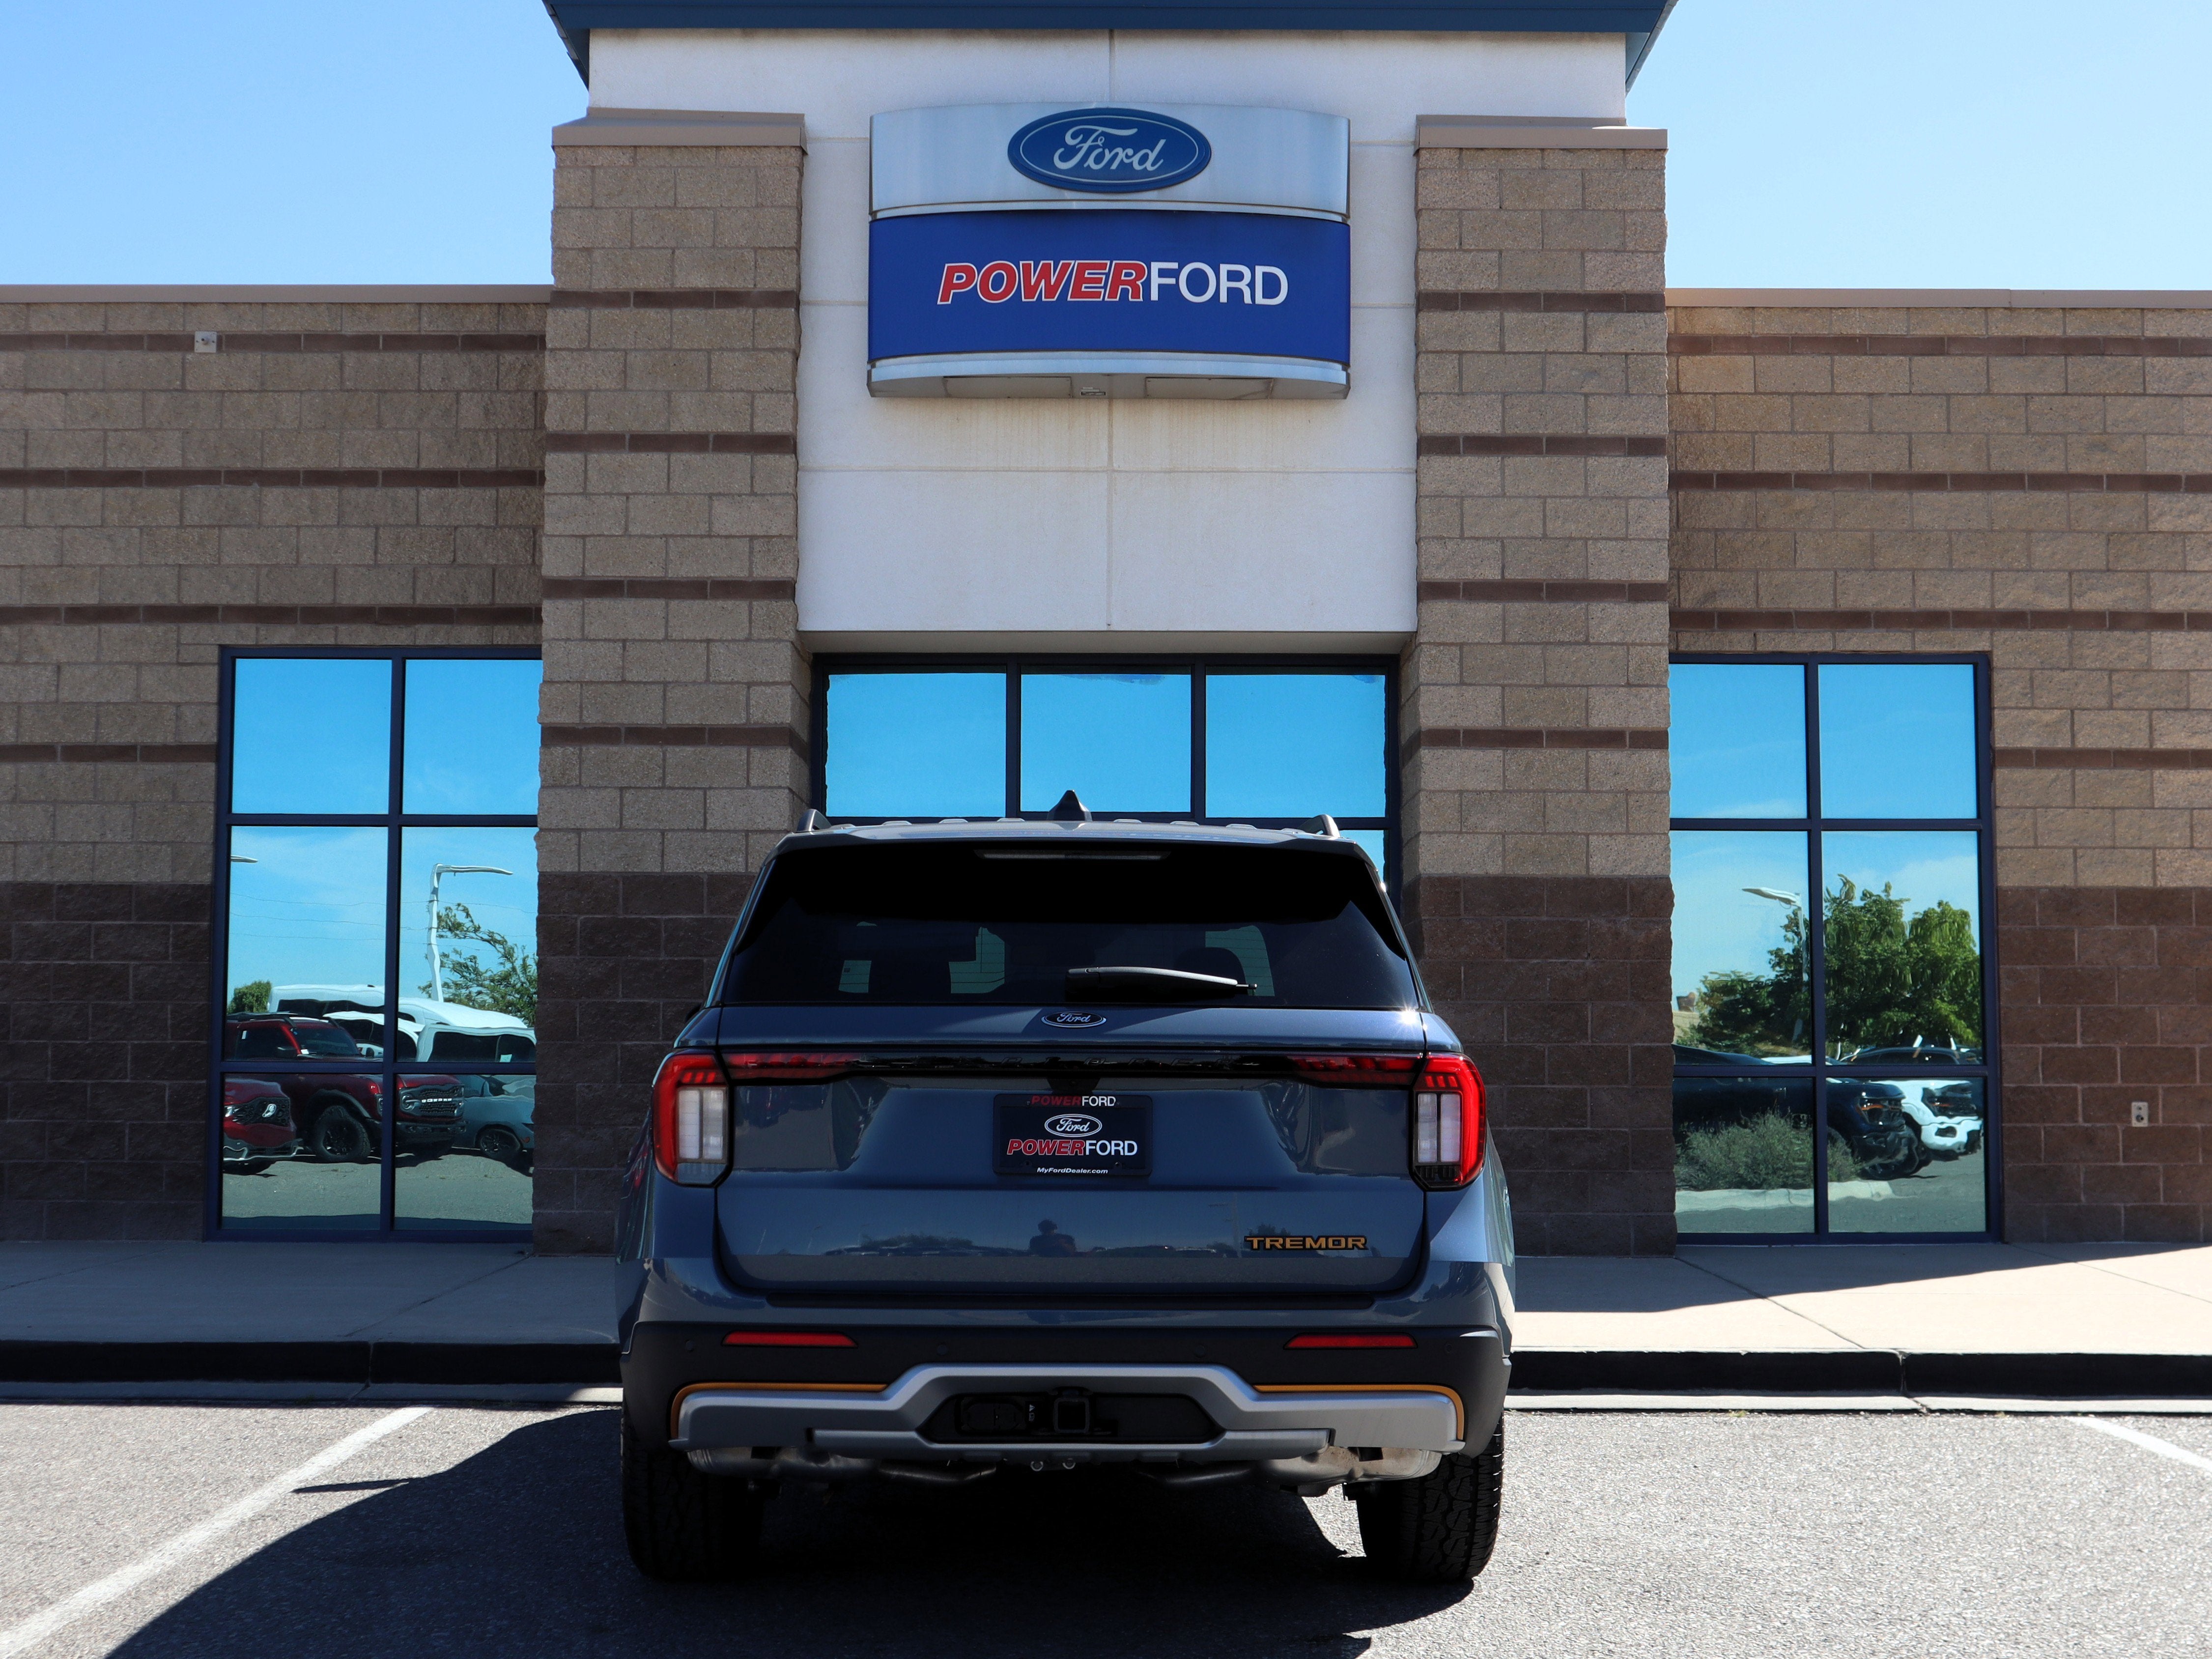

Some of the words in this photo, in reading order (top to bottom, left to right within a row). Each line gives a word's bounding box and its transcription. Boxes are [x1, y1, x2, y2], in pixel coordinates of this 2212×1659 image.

[1053, 124, 1166, 172] Ford
[936, 260, 1289, 306] POWERFORD
[1056, 1011, 1091, 1023] Ford
[1031, 1095, 1116, 1107] POWERFORD
[1056, 1117, 1091, 1132] Ford
[1006, 1139, 1138, 1156] POWERFORD
[1245, 1236, 1368, 1250] TREMOR
